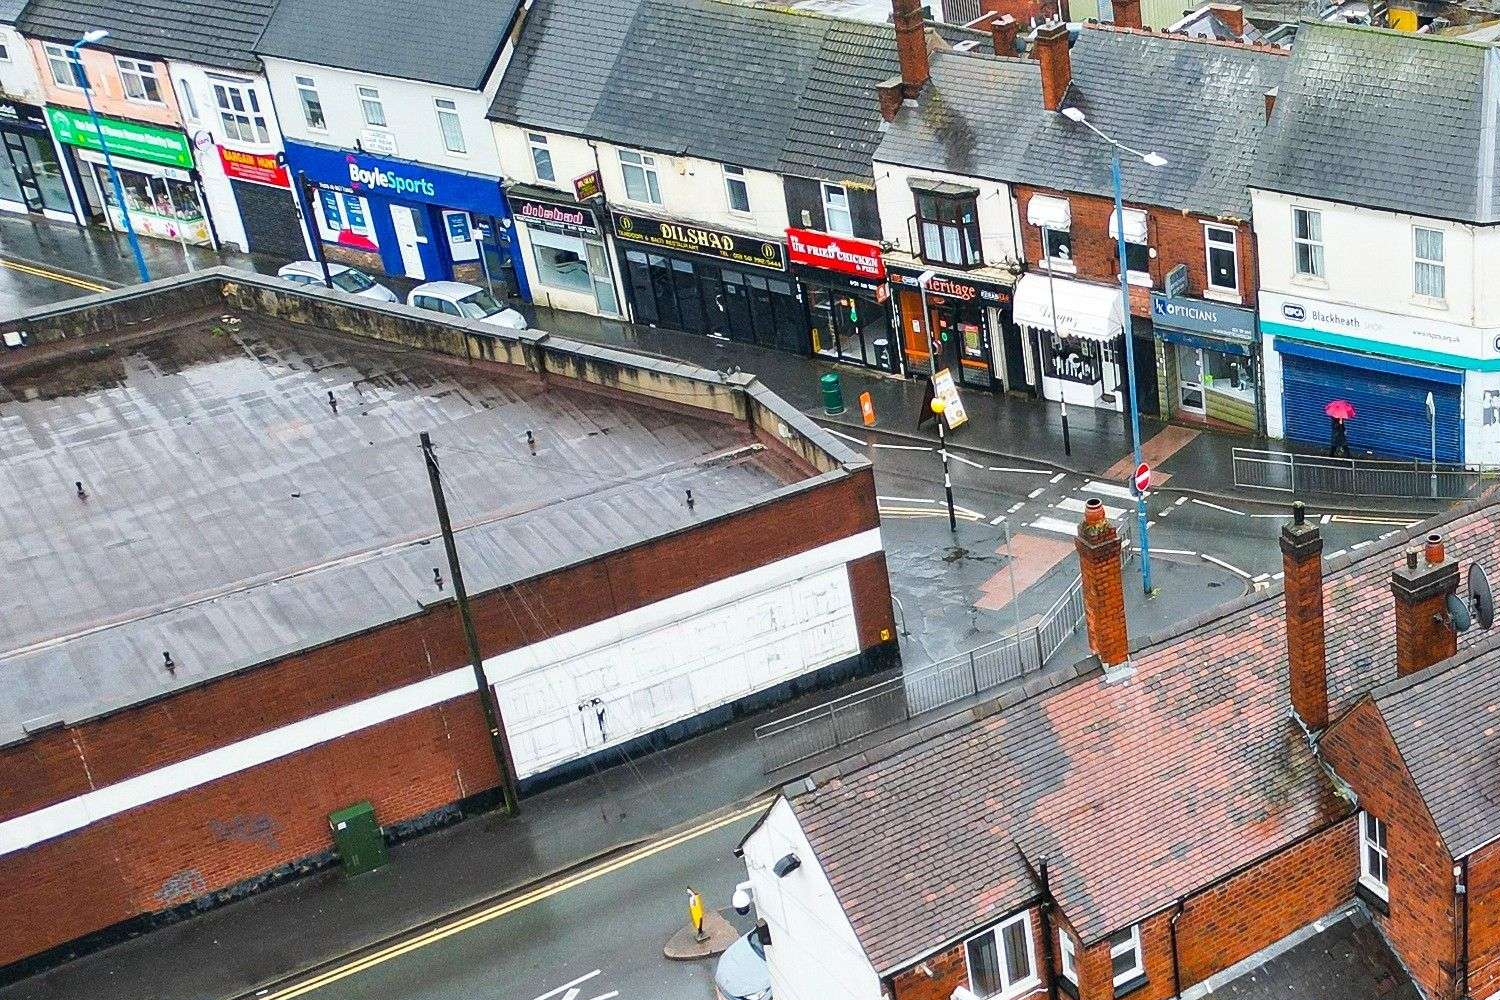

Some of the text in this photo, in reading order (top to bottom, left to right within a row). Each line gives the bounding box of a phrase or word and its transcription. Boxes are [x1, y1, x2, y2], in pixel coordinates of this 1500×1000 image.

[349, 163, 435, 196] BoyleSports
[659, 223, 734, 251] DILSHAD
[1166, 303, 1218, 323] OPTICIANS
[1312, 311, 1360, 328] Blackheath
